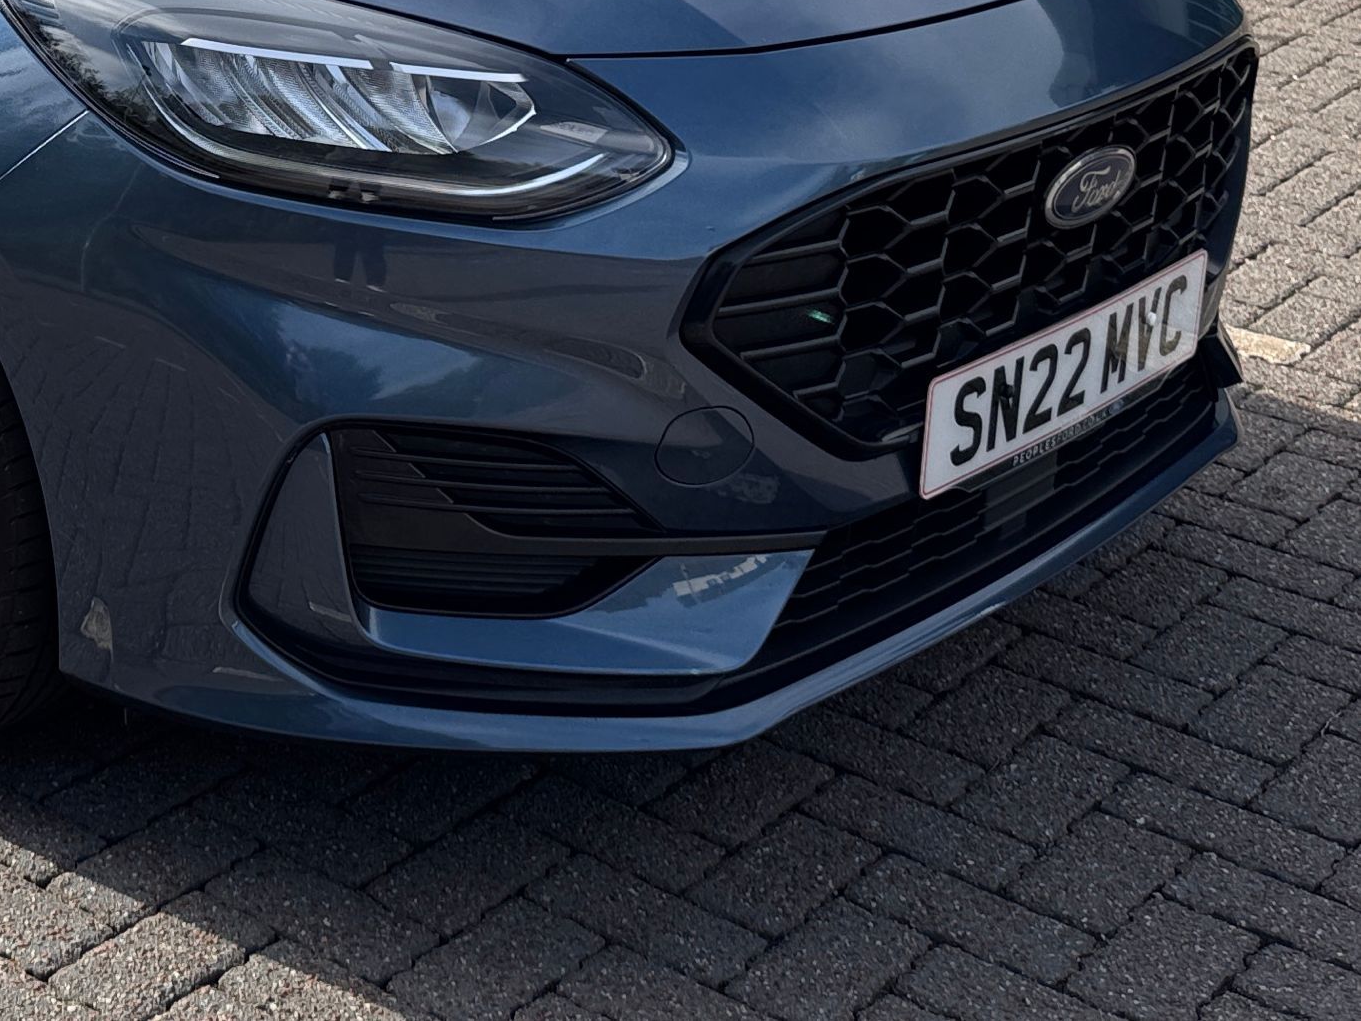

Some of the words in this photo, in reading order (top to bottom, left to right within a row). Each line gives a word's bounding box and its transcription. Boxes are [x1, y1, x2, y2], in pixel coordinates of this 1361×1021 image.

[1071, 166, 1121, 213] Ford
[950, 326, 1092, 467] SN22
[1100, 274, 1188, 395] MVC
